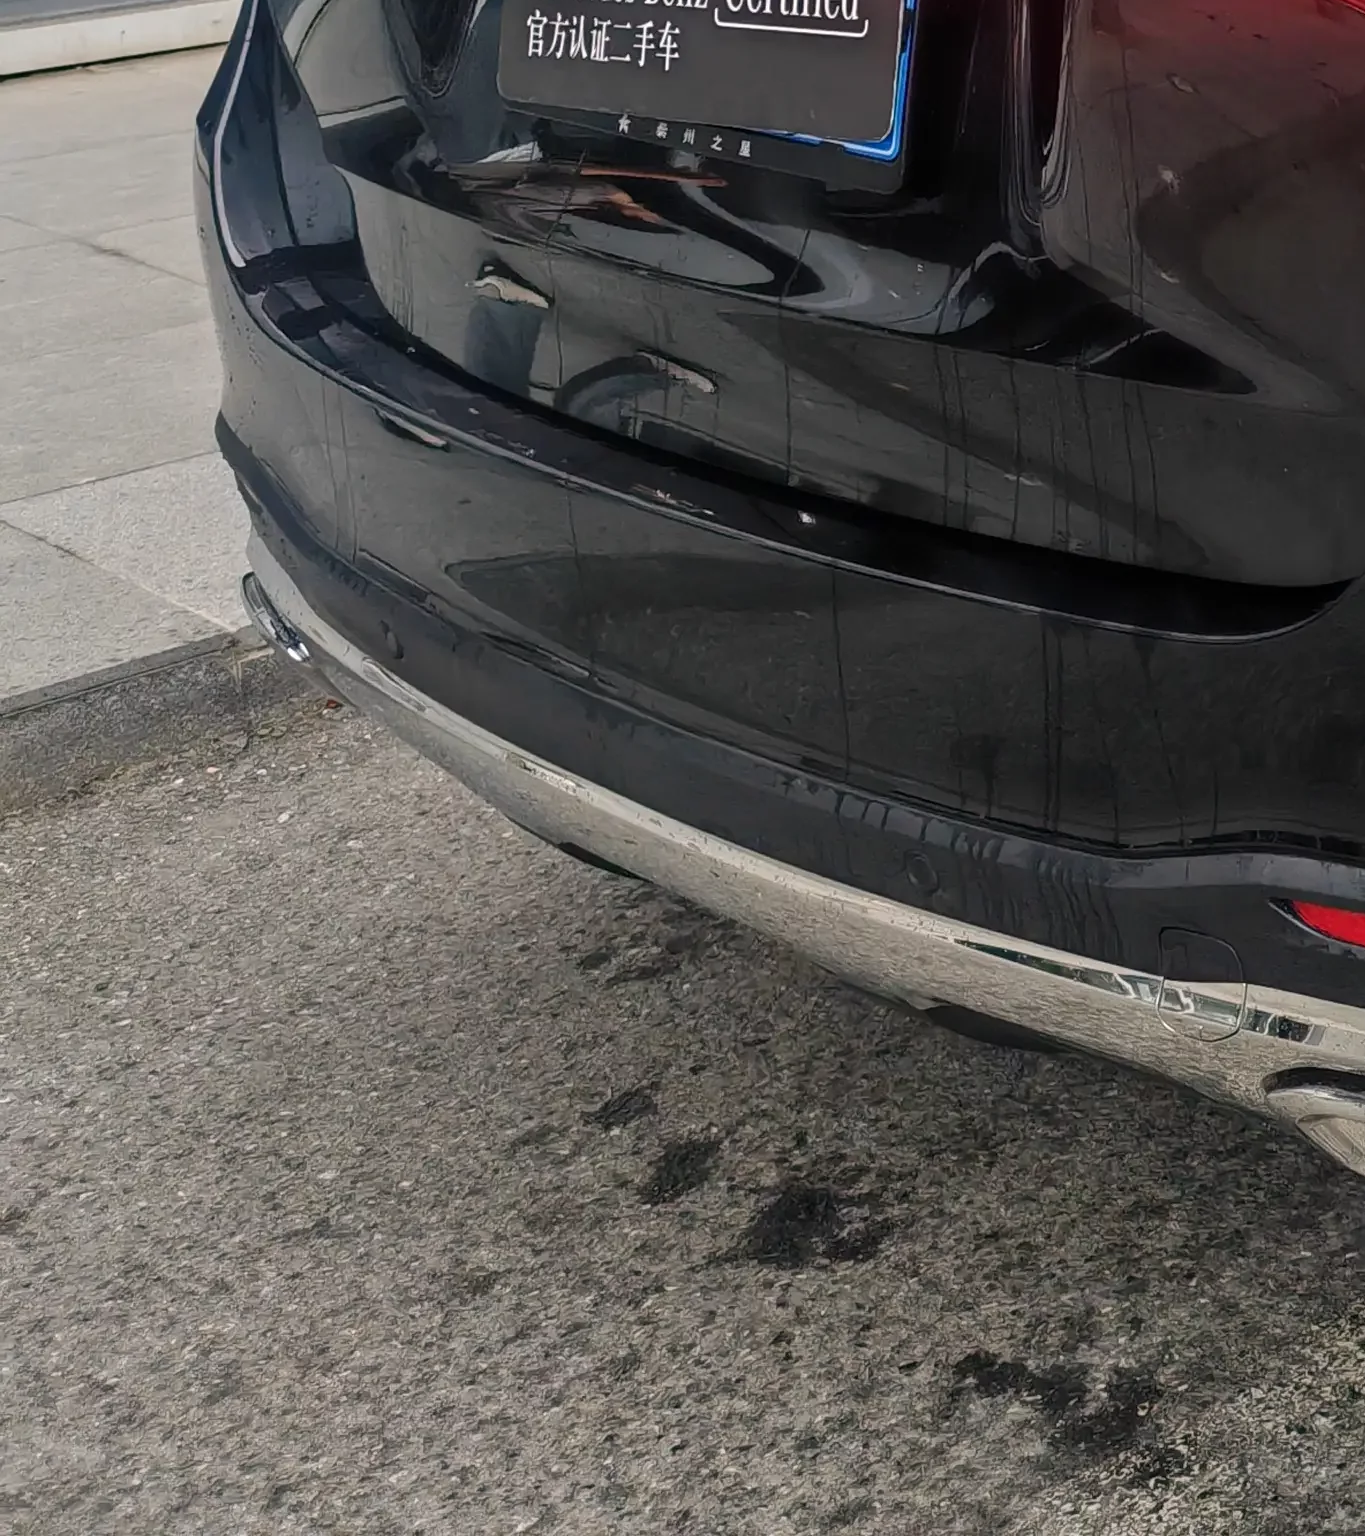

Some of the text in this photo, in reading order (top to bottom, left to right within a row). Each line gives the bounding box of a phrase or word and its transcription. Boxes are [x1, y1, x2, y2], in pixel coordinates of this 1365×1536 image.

[526, 9, 681, 72] 官方认证二手车
